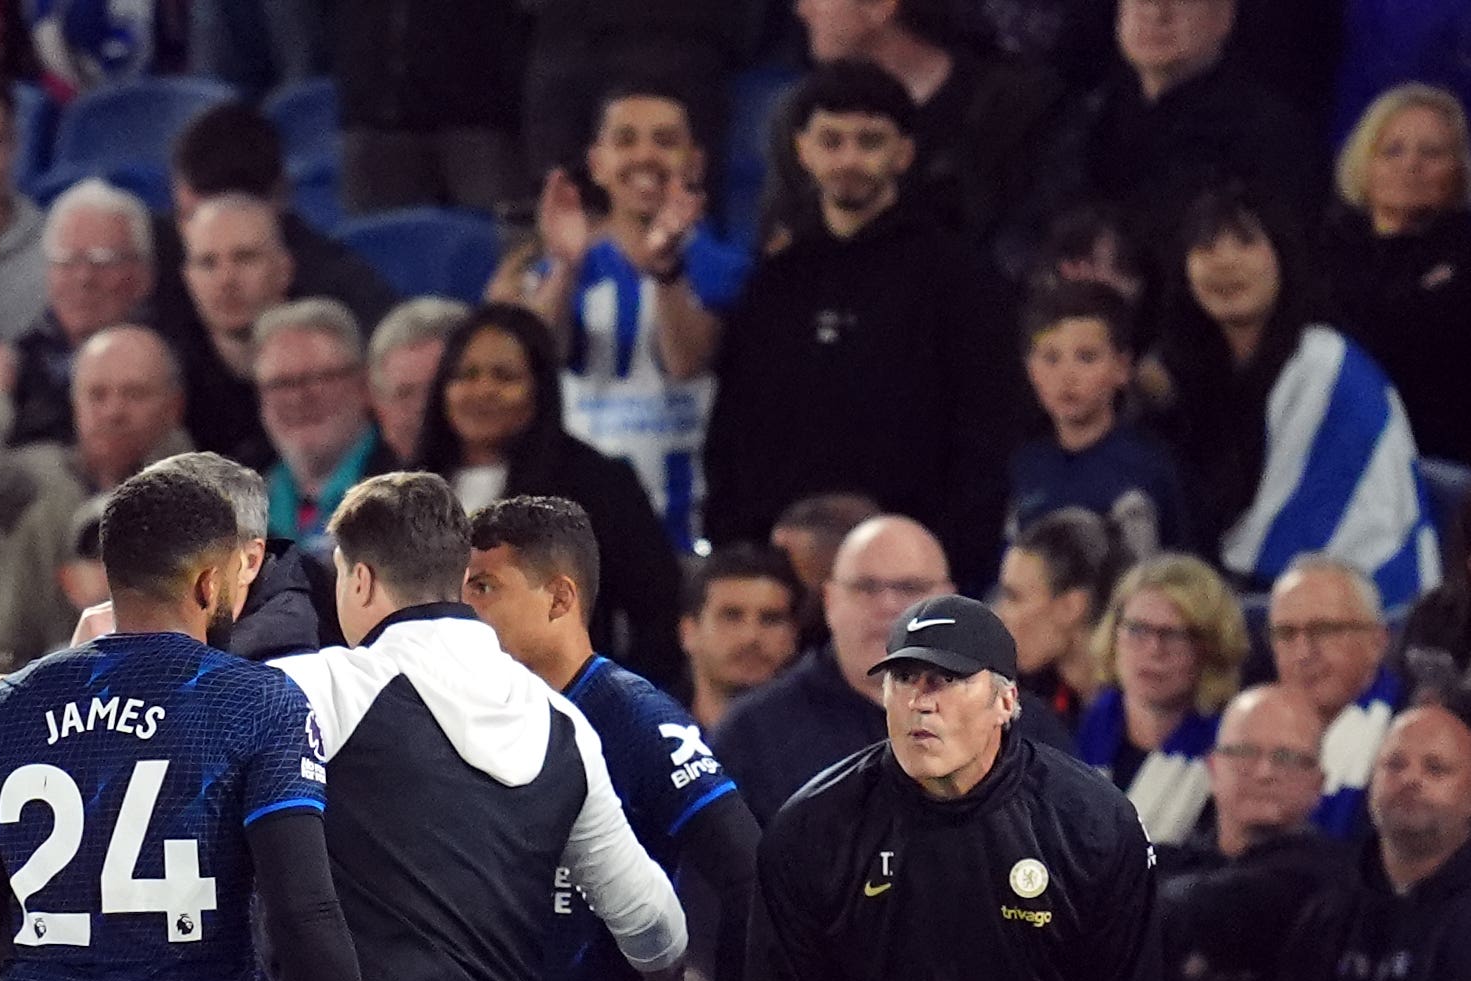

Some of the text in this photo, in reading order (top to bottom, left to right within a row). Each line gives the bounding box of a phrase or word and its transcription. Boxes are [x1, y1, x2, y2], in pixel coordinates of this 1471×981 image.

[45, 696, 166, 745] JAMES
[670, 757, 722, 789] Bing
[1001, 904, 1052, 928] trivago
